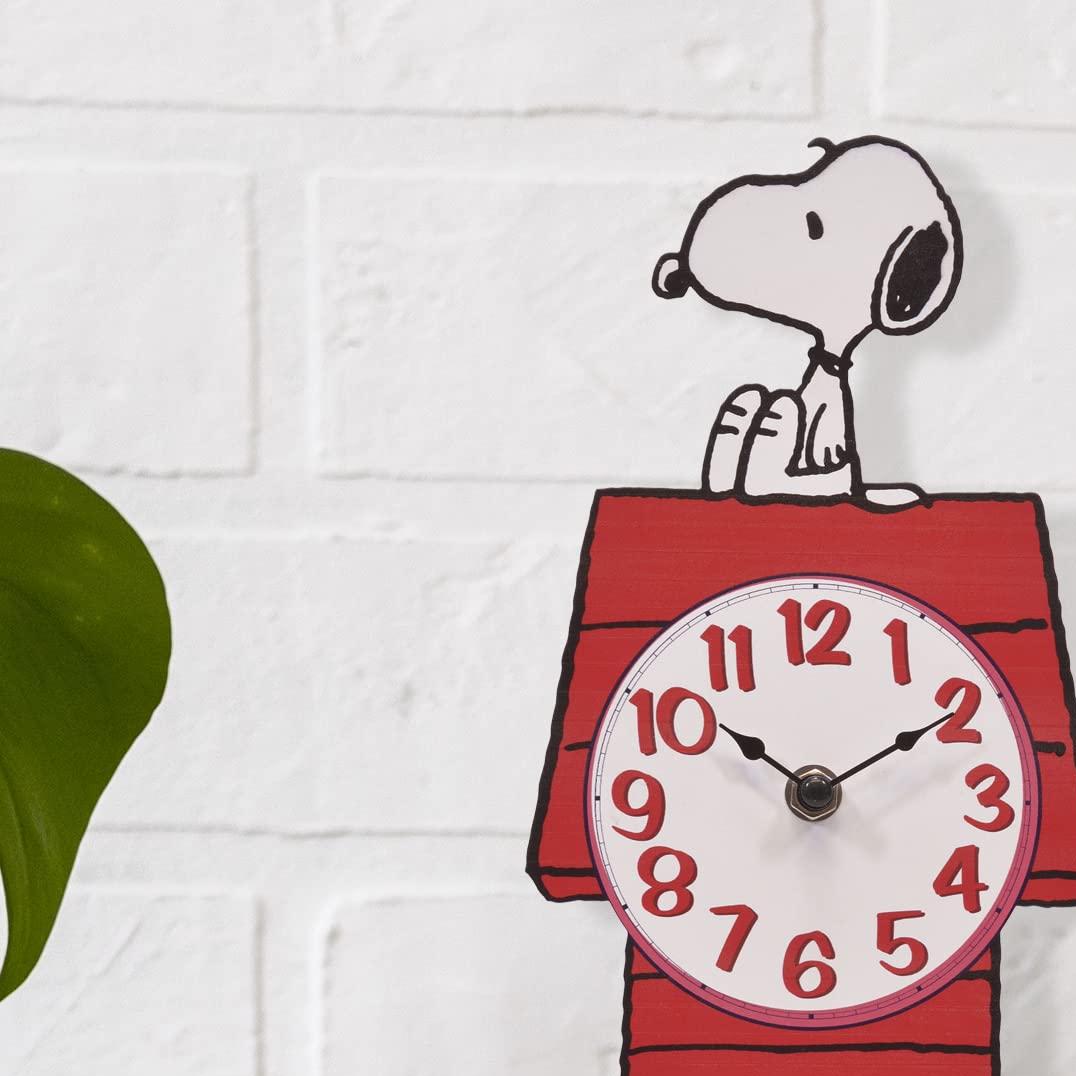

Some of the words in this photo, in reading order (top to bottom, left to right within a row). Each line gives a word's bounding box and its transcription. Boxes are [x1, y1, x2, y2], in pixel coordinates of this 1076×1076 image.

[700, 625, 756, 692] 11
[777, 599, 851, 666] 12
[883, 618, 912, 686] 1
[629, 687, 717, 756] 10
[934, 677, 982, 744] 2
[611, 769, 666, 841] 9
[963, 763, 1015, 832] 3
[637, 846, 698, 917] 8
[932, 844, 989, 914] 4
[709, 904, 758, 973] 7
[782, 930, 837, 999] 6
[876, 910, 929, 976] 5
